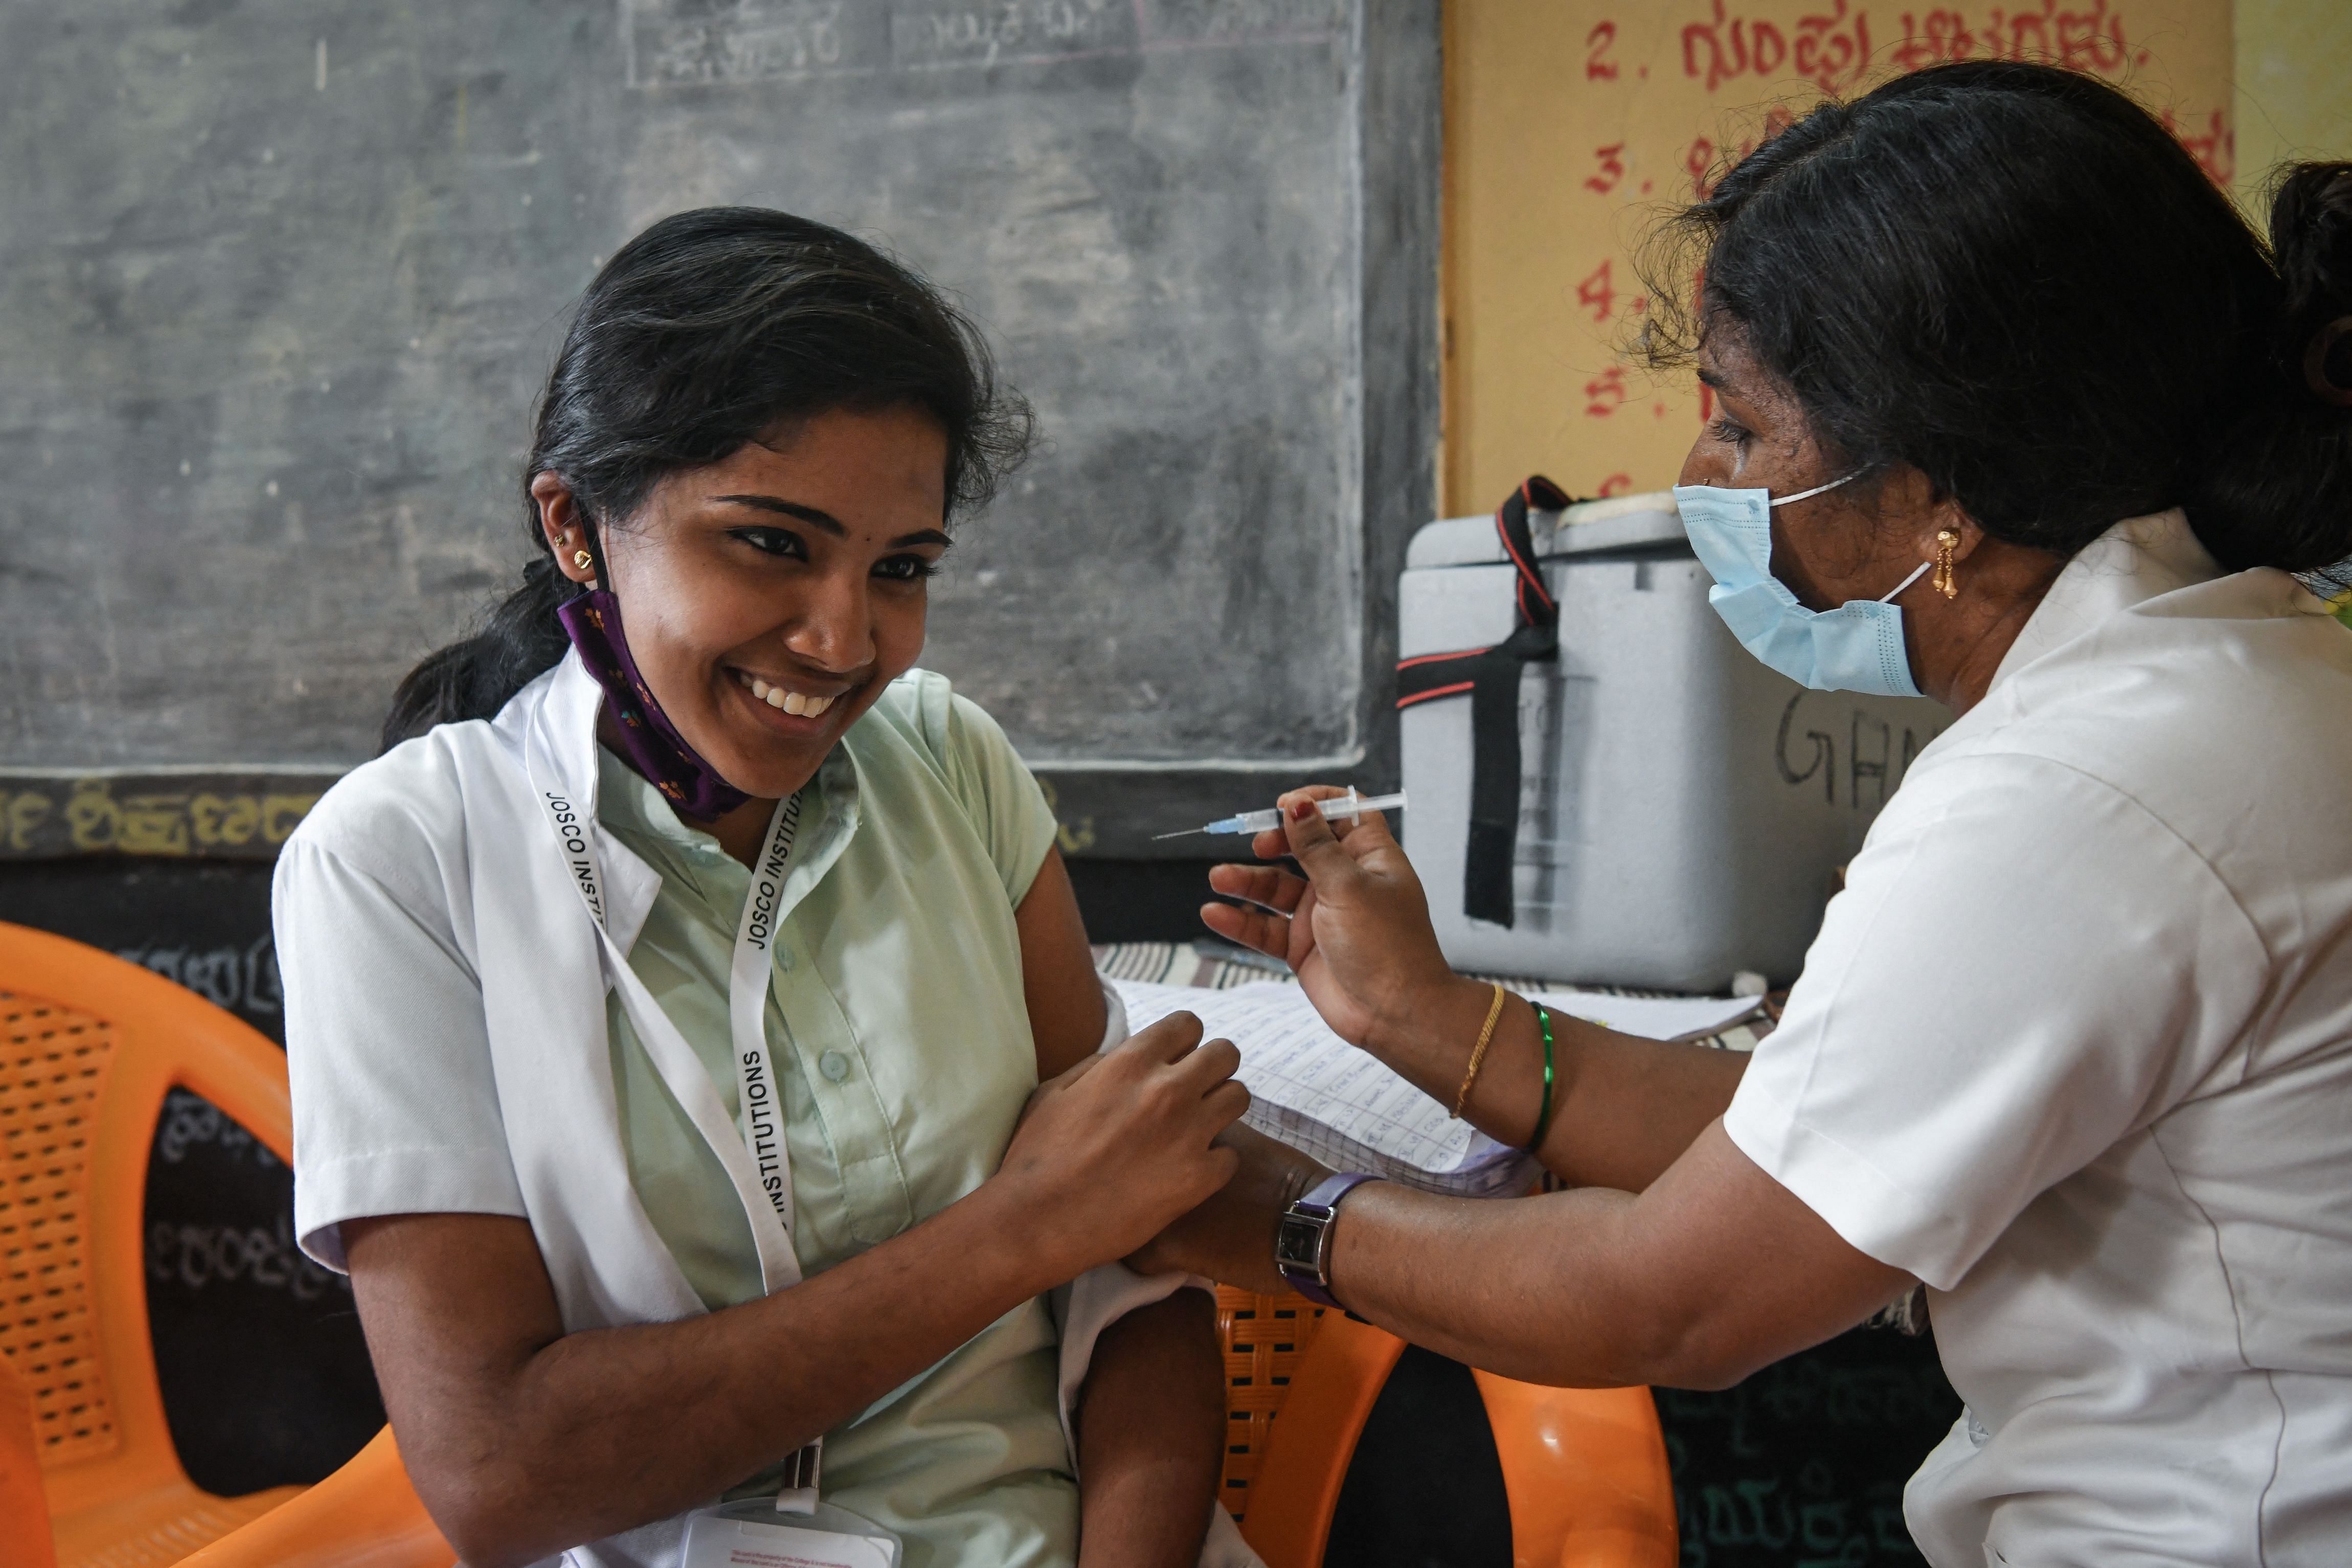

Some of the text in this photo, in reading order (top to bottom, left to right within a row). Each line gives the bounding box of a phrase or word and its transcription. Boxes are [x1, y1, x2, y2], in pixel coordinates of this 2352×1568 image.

[546, 792, 586, 853] JOSCO
[747, 881, 775, 950] JOSCO
[743, 1051, 785, 1213] INSTITUTIONS
